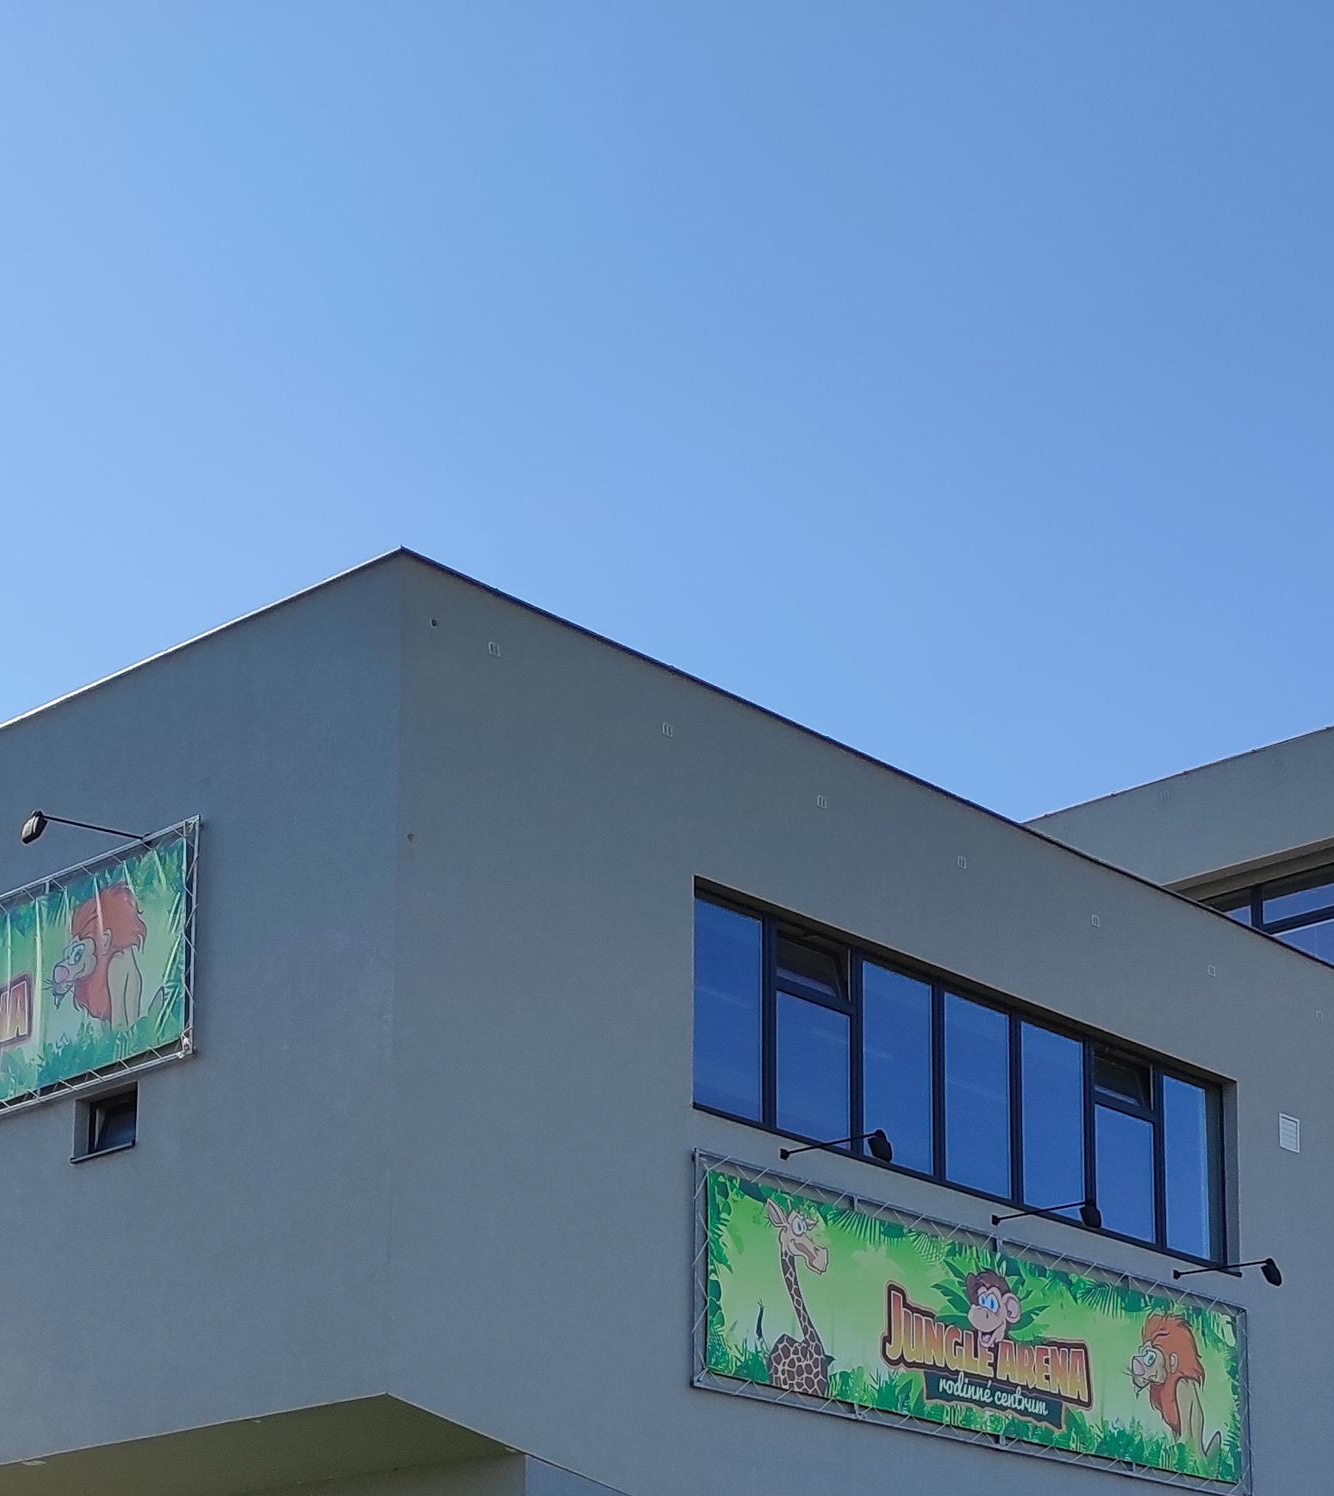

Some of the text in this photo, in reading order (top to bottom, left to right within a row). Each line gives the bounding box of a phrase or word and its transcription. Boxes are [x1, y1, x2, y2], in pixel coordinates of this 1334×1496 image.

[885, 1289, 1088, 1402] JUNGLE ARENA
[938, 1371, 1049, 1416] rodinné centrum
